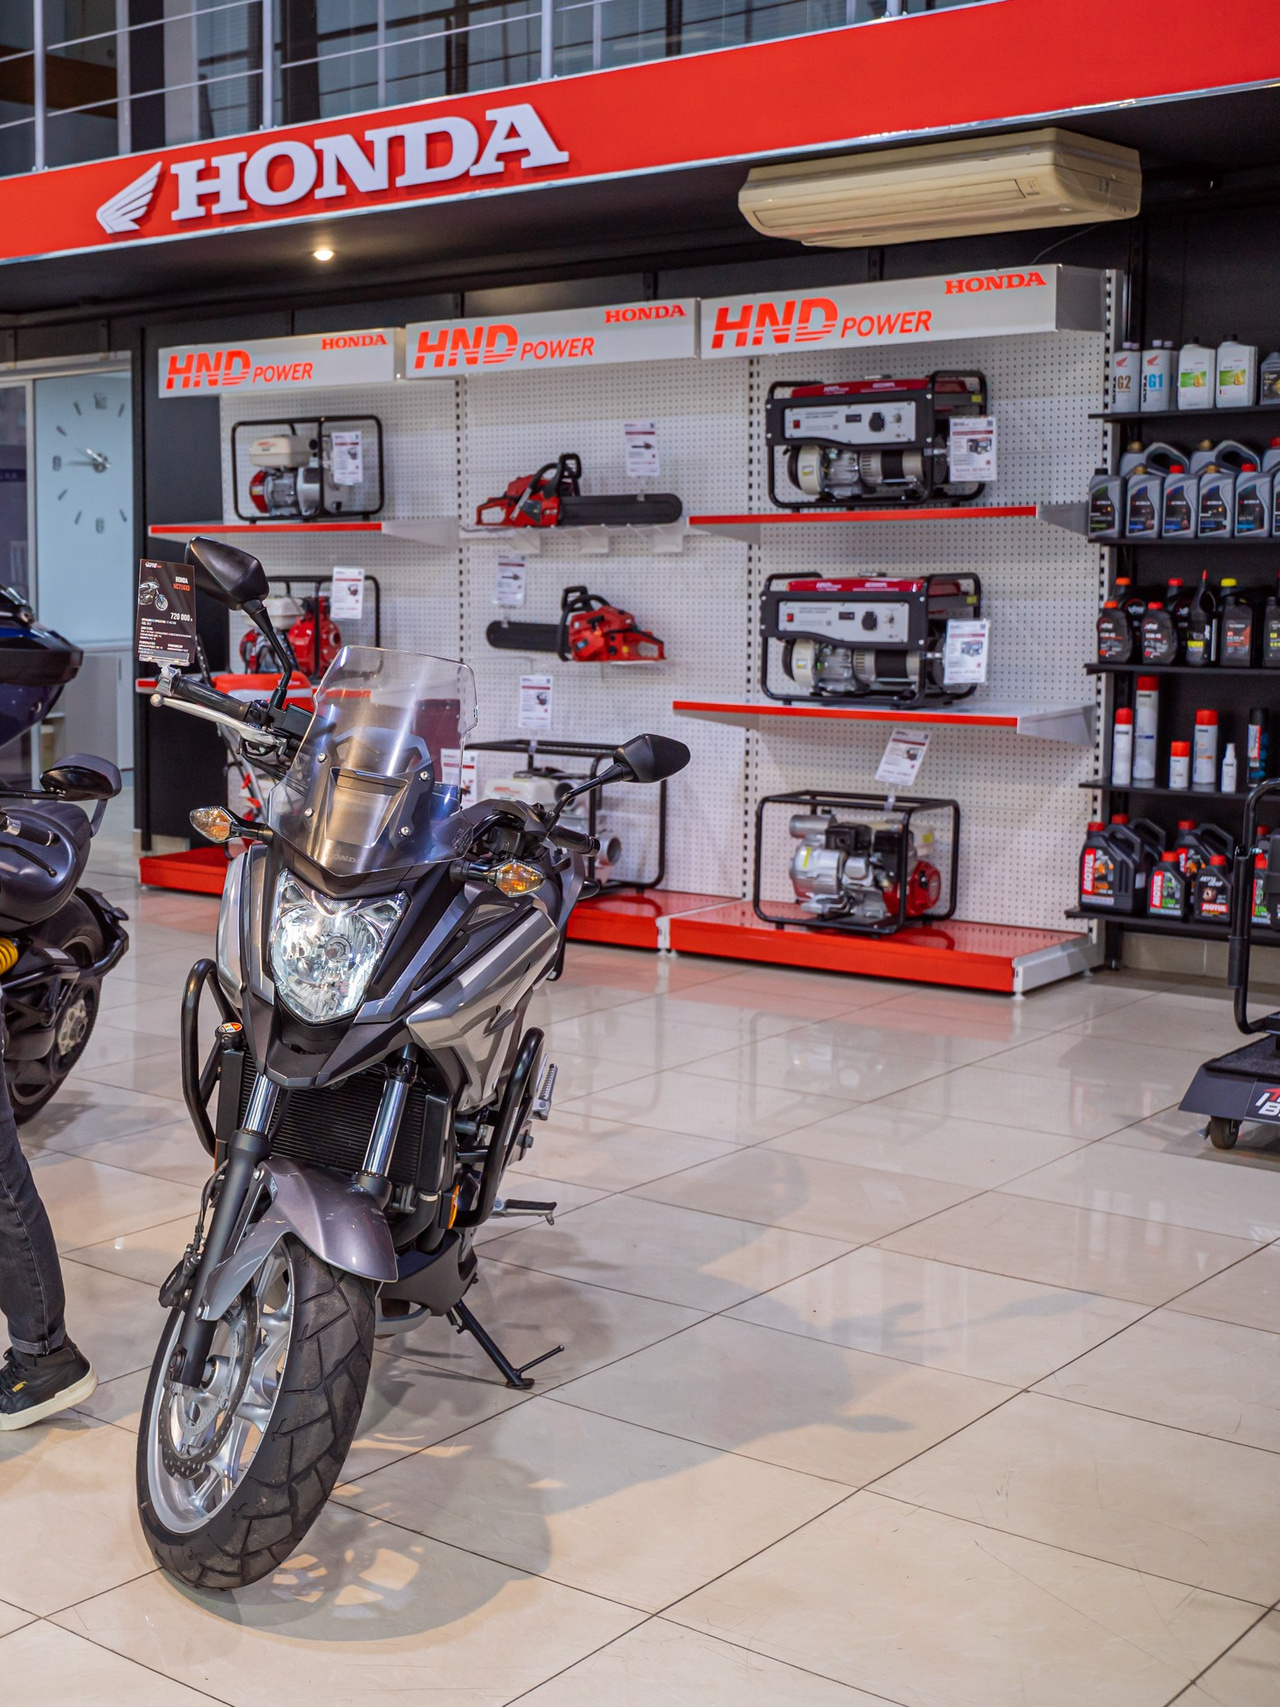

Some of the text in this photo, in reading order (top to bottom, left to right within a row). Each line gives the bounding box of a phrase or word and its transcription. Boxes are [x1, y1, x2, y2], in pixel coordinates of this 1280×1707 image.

[170, 103, 570, 221] HONDA
[943, 271, 1046, 295] HONDA
[604, 304, 686, 323] HONDA
[711, 297, 933, 349] HND POWER
[320, 334, 388, 350] HONDA
[414, 324, 595, 369] HND POWER
[165, 349, 314, 390] HND POWER
[1117, 375, 1131, 389] G2
[1148, 373, 1163, 388] G1
[1201, 902, 1227, 912] MOTUL
